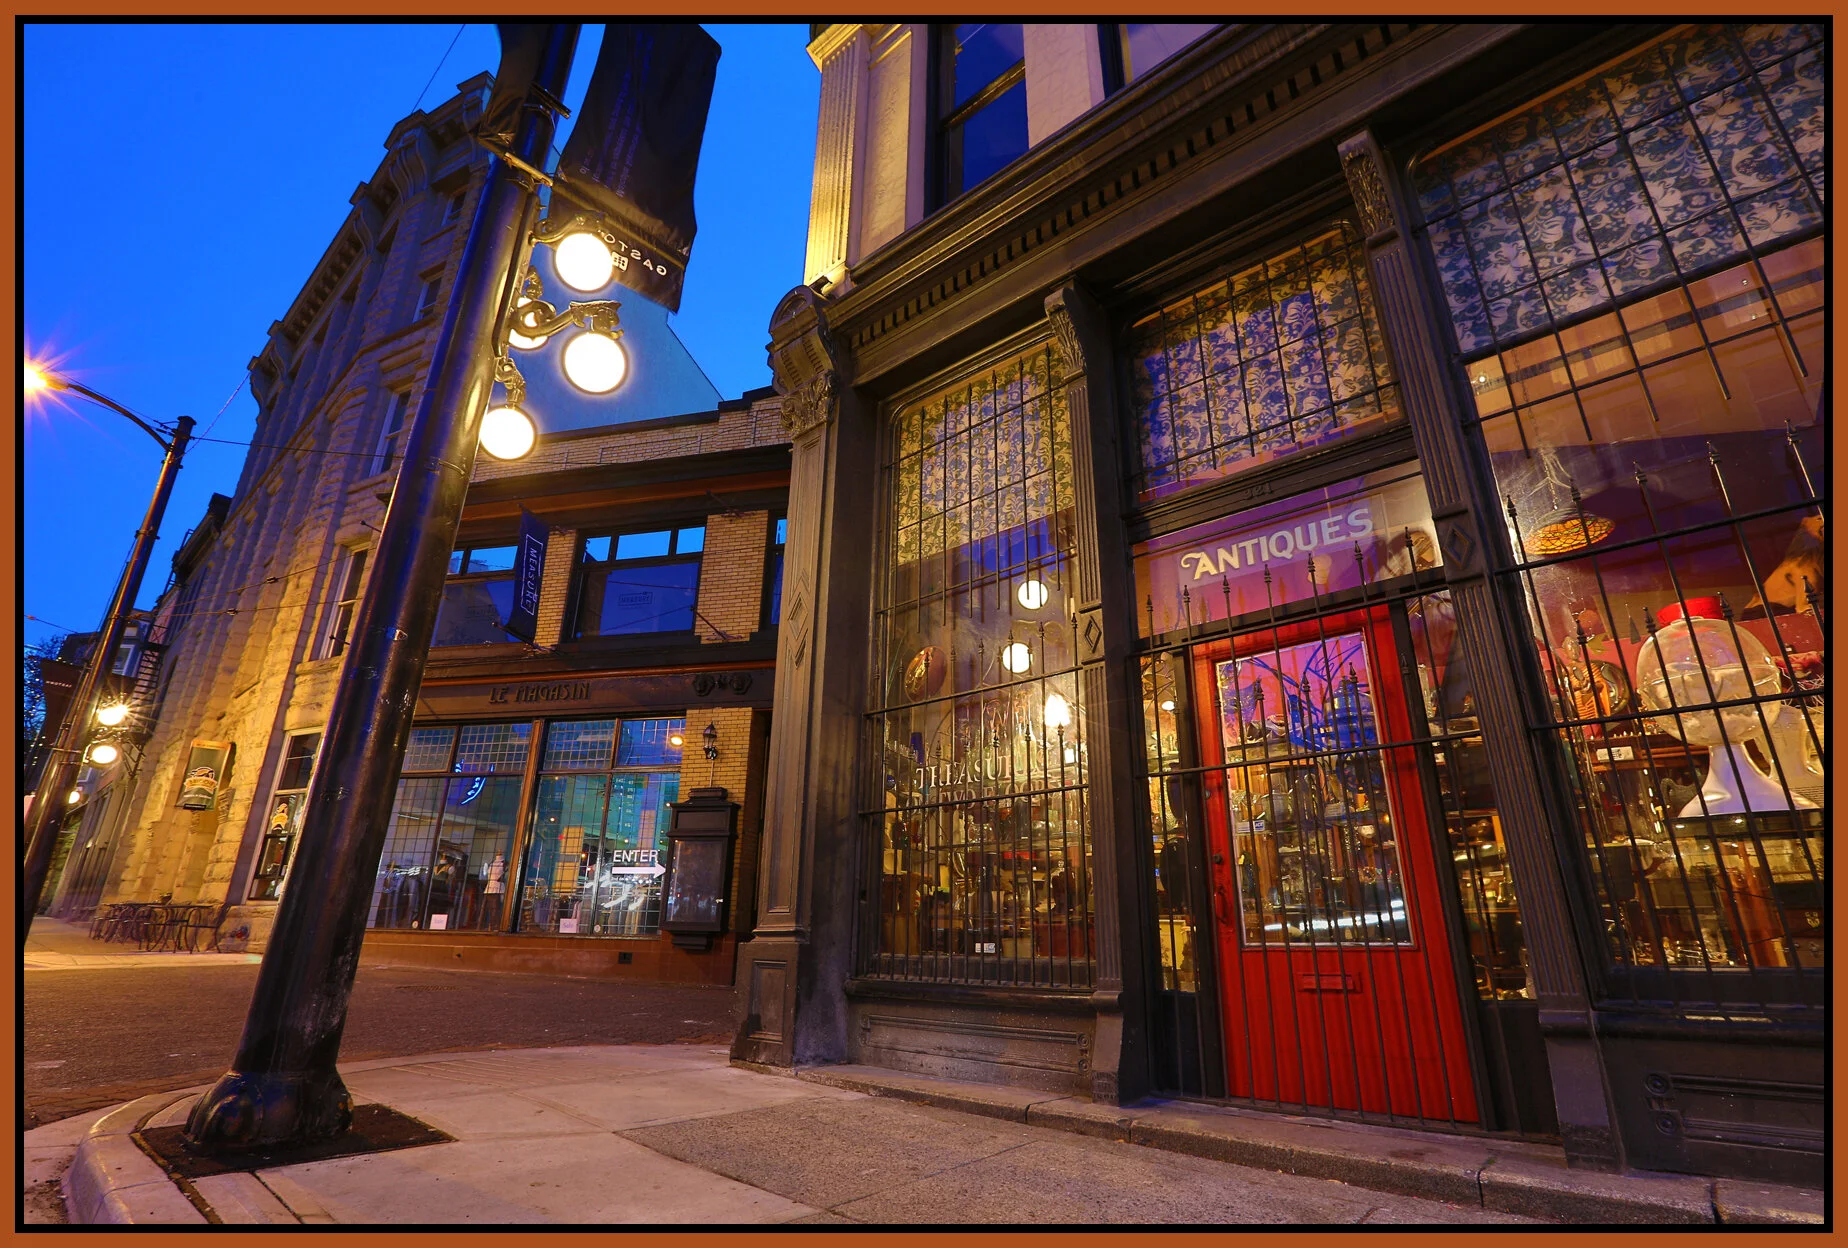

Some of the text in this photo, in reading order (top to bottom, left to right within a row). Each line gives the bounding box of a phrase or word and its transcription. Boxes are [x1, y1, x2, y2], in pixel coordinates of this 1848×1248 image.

[1180, 508, 1374, 581] ANTIQUES
[525, 547, 538, 608] MEASURE
[488, 682, 591, 703] LE MAGASIN
[612, 849, 659, 863] ENTER
